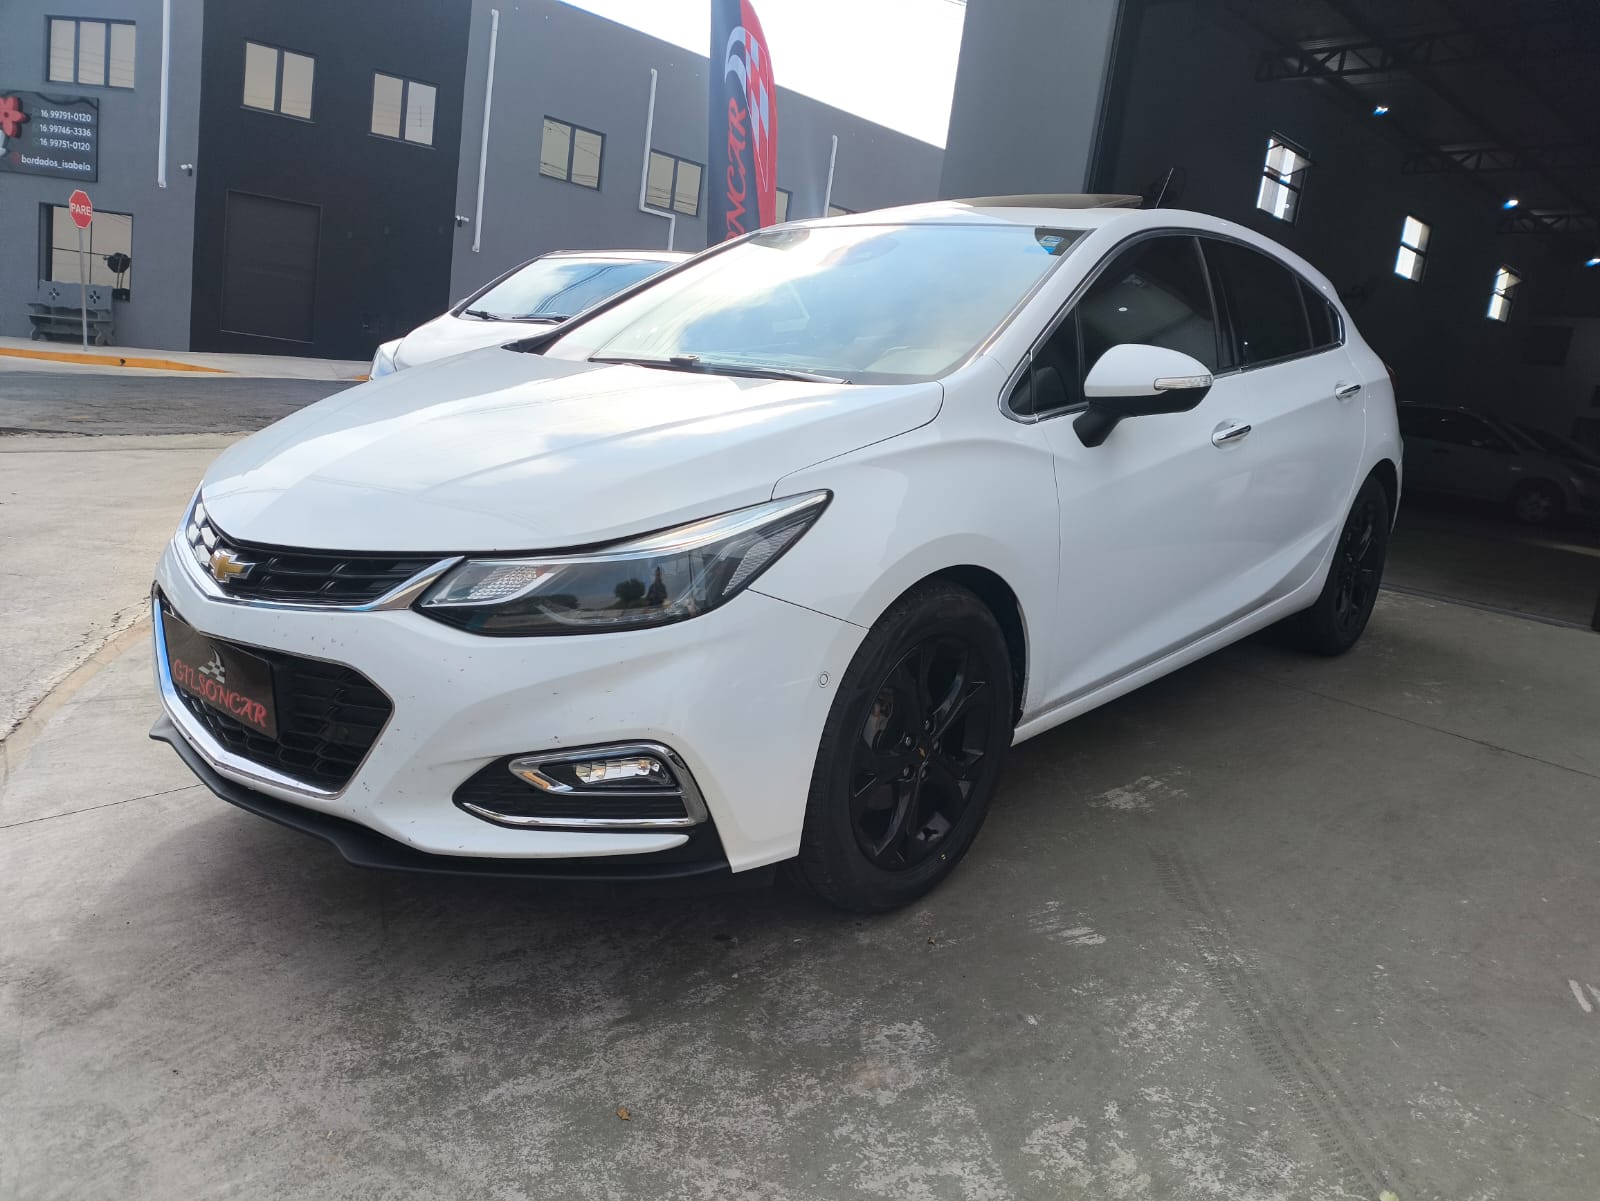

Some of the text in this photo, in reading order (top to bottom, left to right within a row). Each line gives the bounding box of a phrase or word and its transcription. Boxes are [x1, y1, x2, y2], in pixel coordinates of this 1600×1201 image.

[41, 110, 91, 122] 16 99791-0120
[40, 124, 91, 137] 16 99746-3336
[40, 138, 91, 151] 16 99751-0120
[21, 154, 91, 171] bordados_isabela
[70, 202, 92, 216] PARE
[173, 659, 267, 727] GILSONCAR
